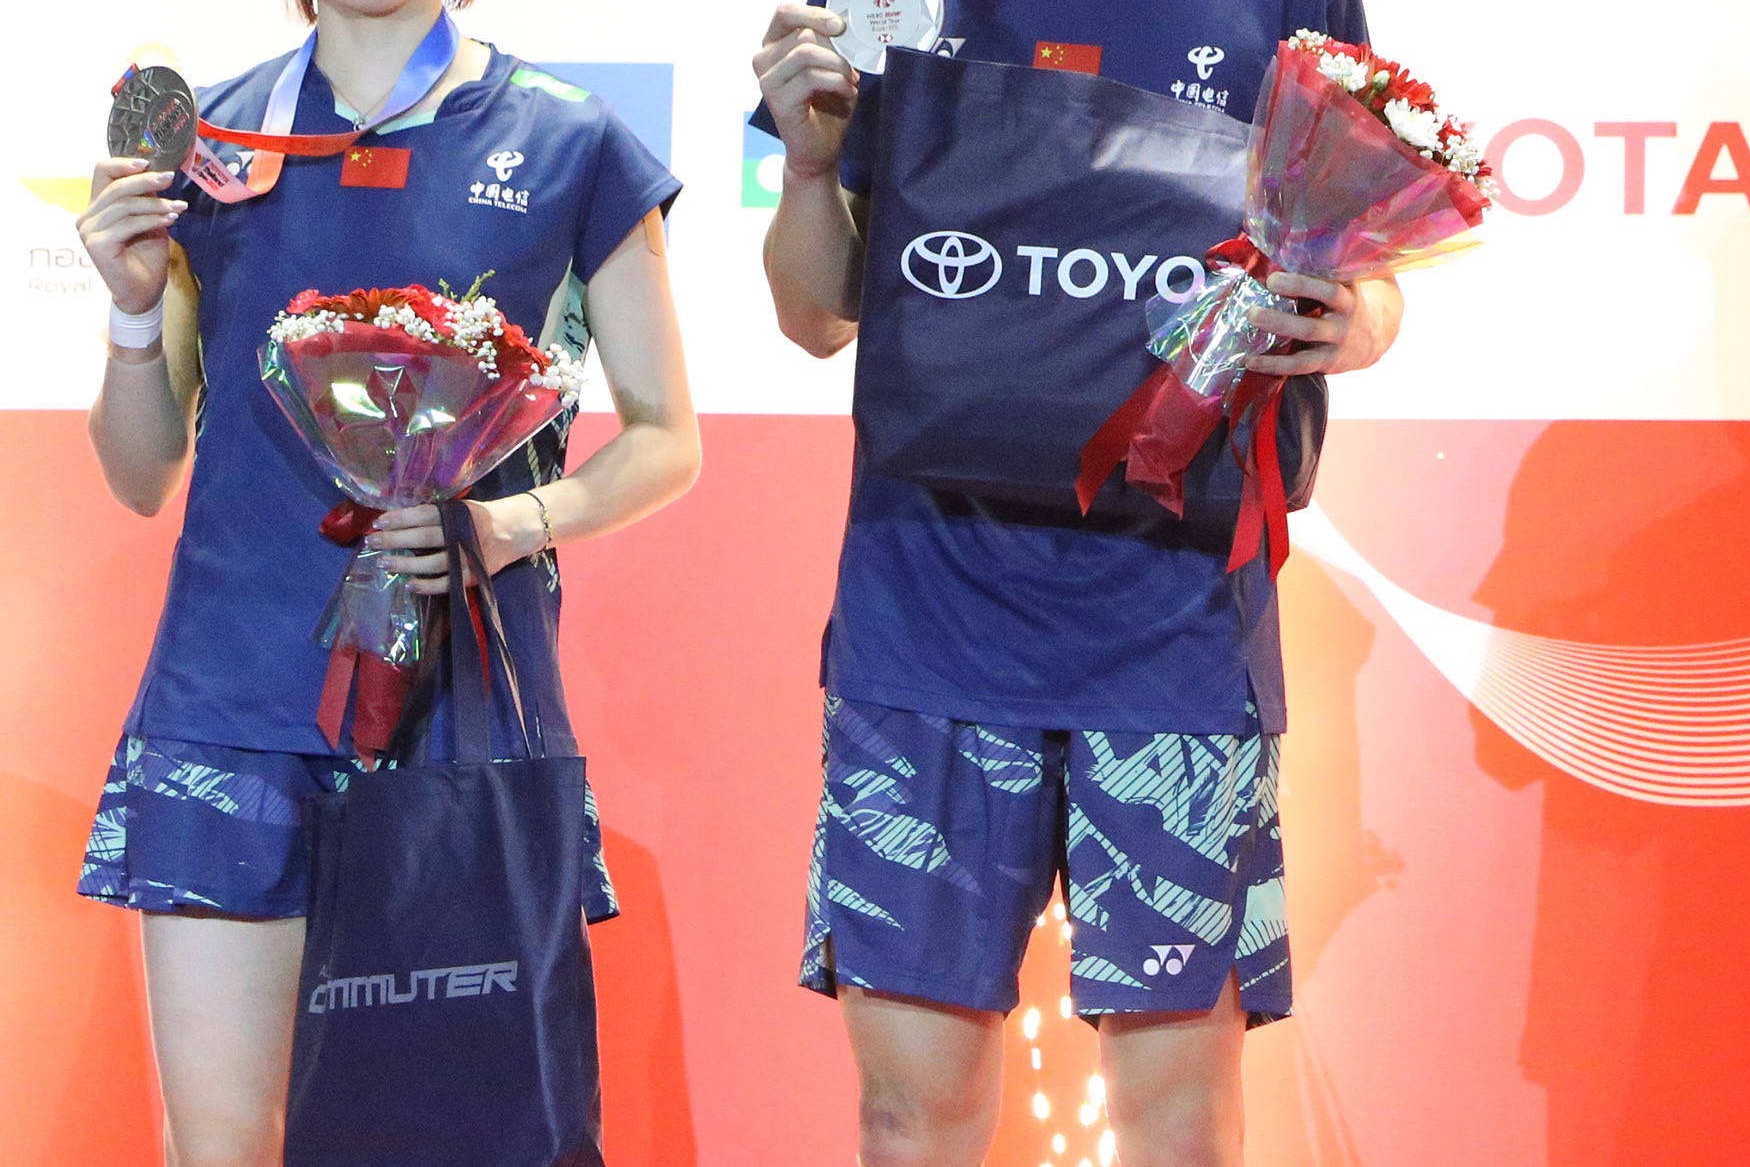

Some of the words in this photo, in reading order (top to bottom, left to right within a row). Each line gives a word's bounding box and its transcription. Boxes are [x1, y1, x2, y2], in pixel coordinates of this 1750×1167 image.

[1170, 79, 1230, 107] 中国电信
[468, 196, 493, 206] CHINA
[494, 200, 528, 214] TELECOM
[469, 180, 531, 206] 中国电信
